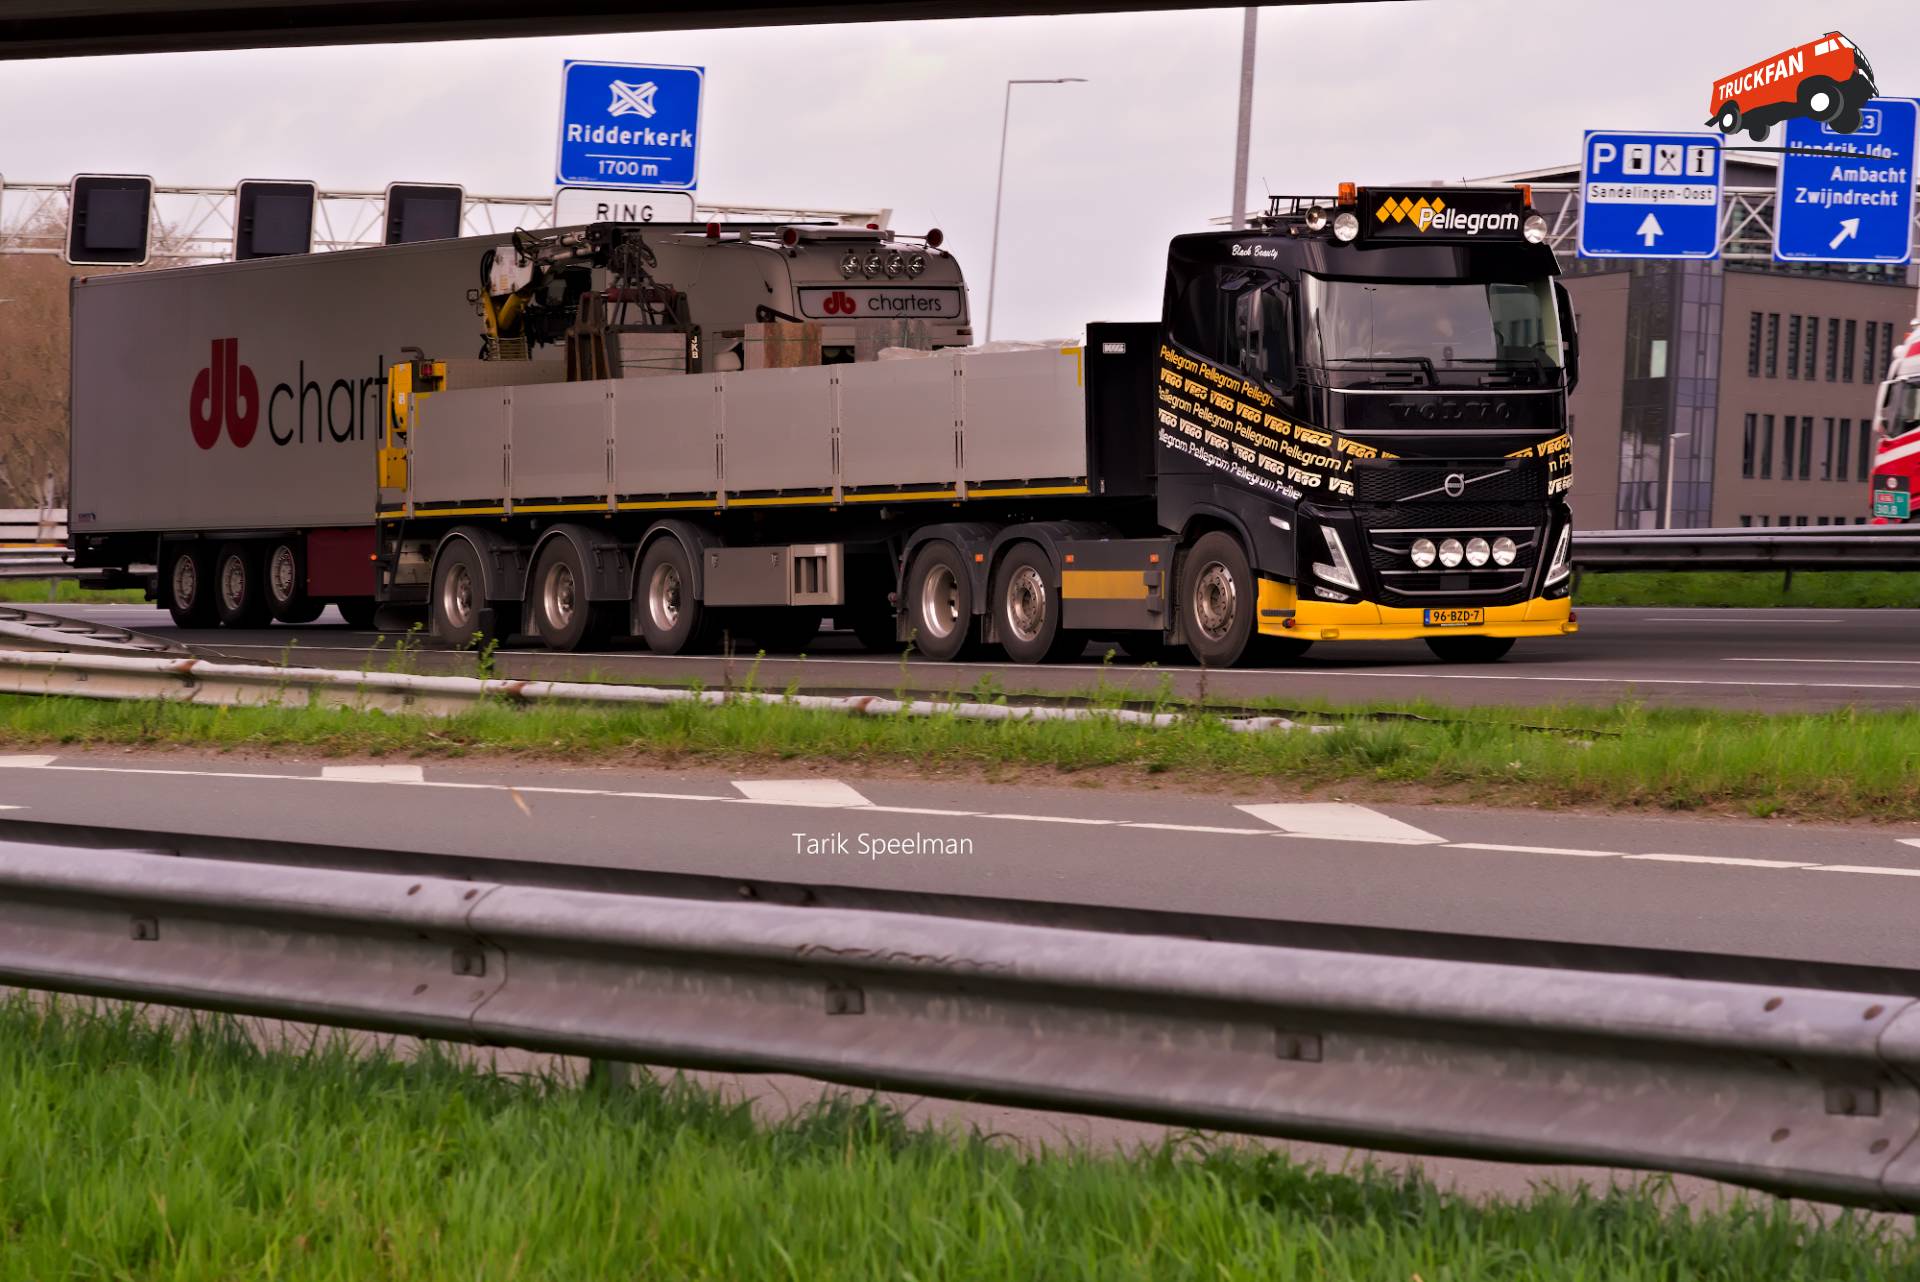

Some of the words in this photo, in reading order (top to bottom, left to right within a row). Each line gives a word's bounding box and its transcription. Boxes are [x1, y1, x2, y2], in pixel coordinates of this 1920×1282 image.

[567, 123, 693, 148] Ridderkerk
[598, 160, 639, 175] 1700
[641, 164, 658, 176] m
[1830, 165, 1908, 184] Ambacht
[1591, 185, 1712, 202] Sandelingen-Oost
[1794, 187, 1899, 209] Zwijndrecht
[596, 203, 654, 222] RING
[1418, 207, 1520, 235] Pellegrom
[1231, 244, 1253, 257] Black
[1254, 244, 1279, 260] Beauty
[823, 291, 856, 315] db
[867, 293, 942, 312] charters
[691, 335, 699, 358] JKB
[1160, 344, 1198, 374] Pellegrom
[1199, 362, 1241, 393] Pellegrom
[190, 337, 260, 450] db
[268, 354, 390, 446] chart
[1161, 367, 1184, 389] VEGO
[1184, 378, 1209, 401] VEGO
[1210, 390, 1235, 412] VEGO
[1236, 401, 1263, 423] VEGO
[1263, 413, 1291, 435] VEGO
[1294, 425, 1333, 447] VEGO
[1337, 438, 1378, 459] VEGO
[1192, 402, 1234, 432] Pellegrom
[1234, 421, 1279, 451] Pellegrom
[1280, 440, 1342, 471] Pellegrom
[1179, 418, 1203, 440] VEGO
[1204, 429, 1229, 451] VEGO
[1231, 441, 1257, 463] VEGO
[1258, 452, 1285, 475] VEGO
[1287, 465, 1322, 487] VEGO
[1328, 477, 1354, 497] VEG
[1188, 442, 1230, 471] Pellegrom
[1230, 461, 1275, 492] Pellegrom
[1433, 611, 1480, 622] 96-BZD-7
